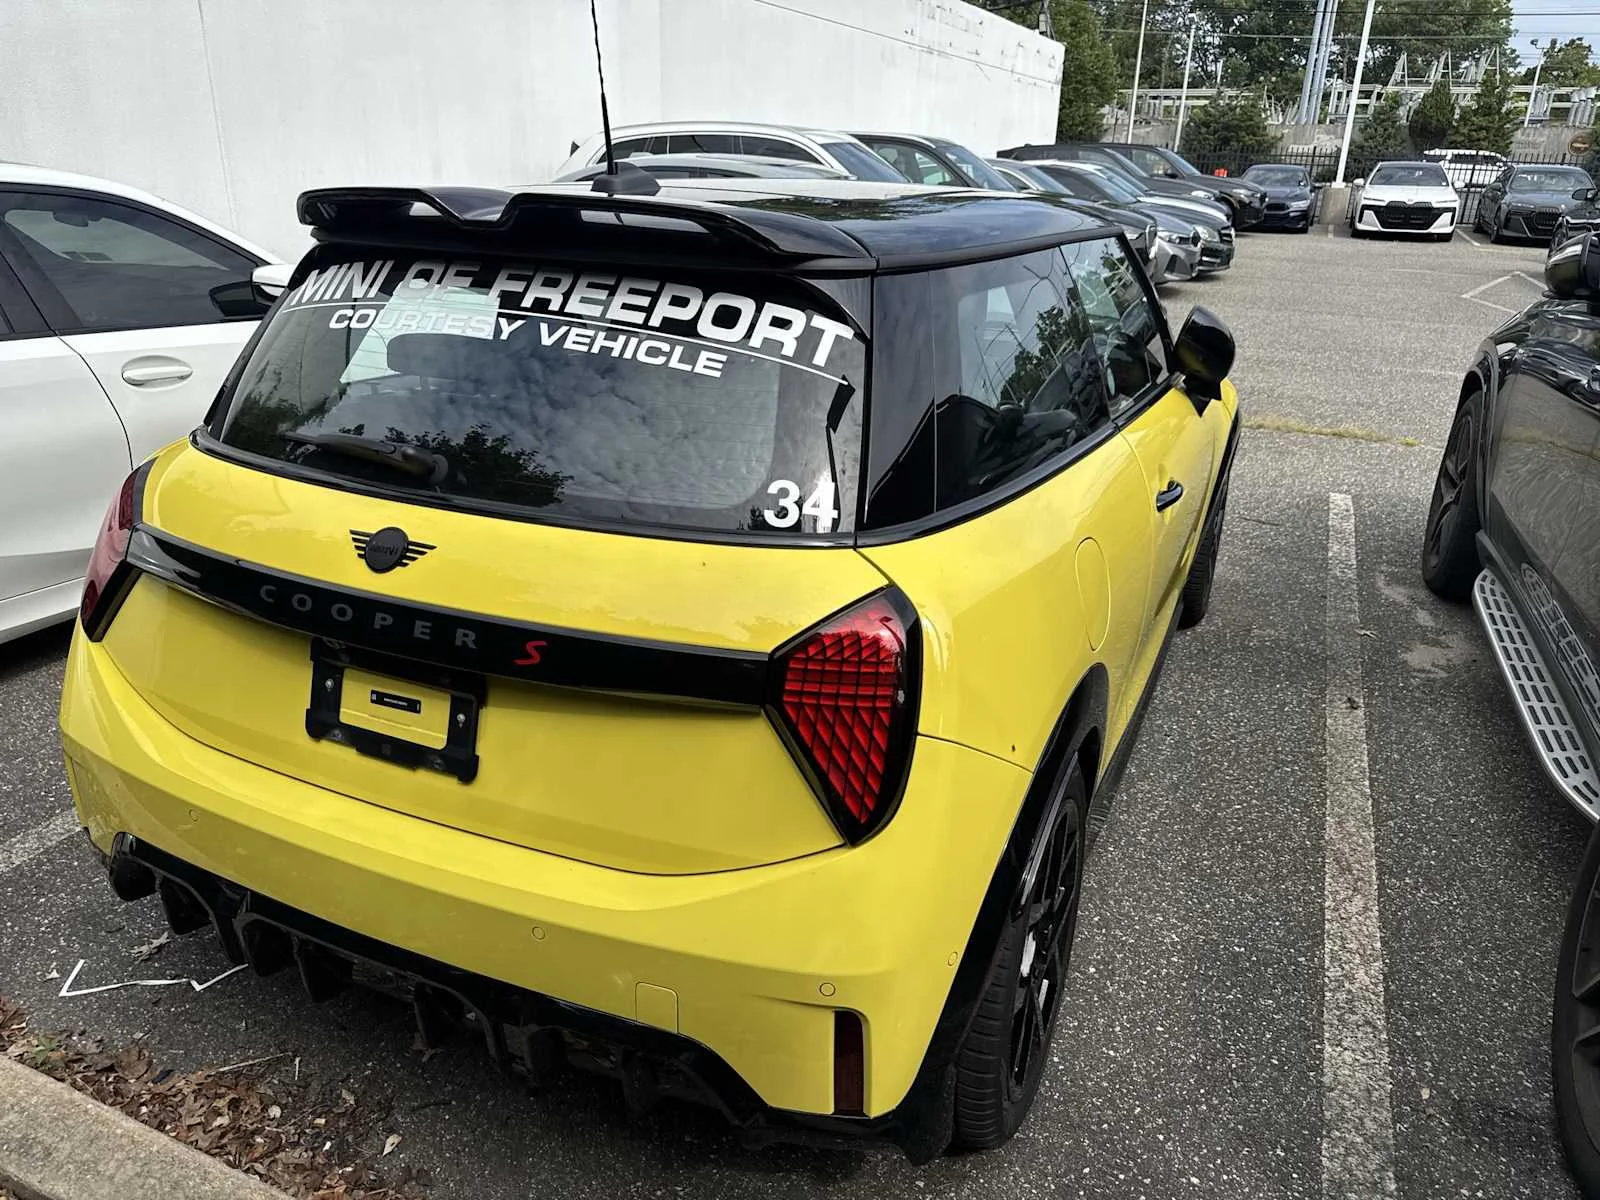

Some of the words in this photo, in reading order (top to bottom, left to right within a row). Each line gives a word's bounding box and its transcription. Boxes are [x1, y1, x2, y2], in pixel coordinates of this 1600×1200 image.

[290, 260, 395, 306] MINI
[400, 261, 481, 302] OF
[487, 267, 855, 368] FREEPORT
[328, 309, 526, 341] COURTESY
[539, 322, 728, 378] VEHICLE
[763, 479, 838, 533] 34
[259, 585, 477, 649] COOPER
[514, 640, 548, 665] S
